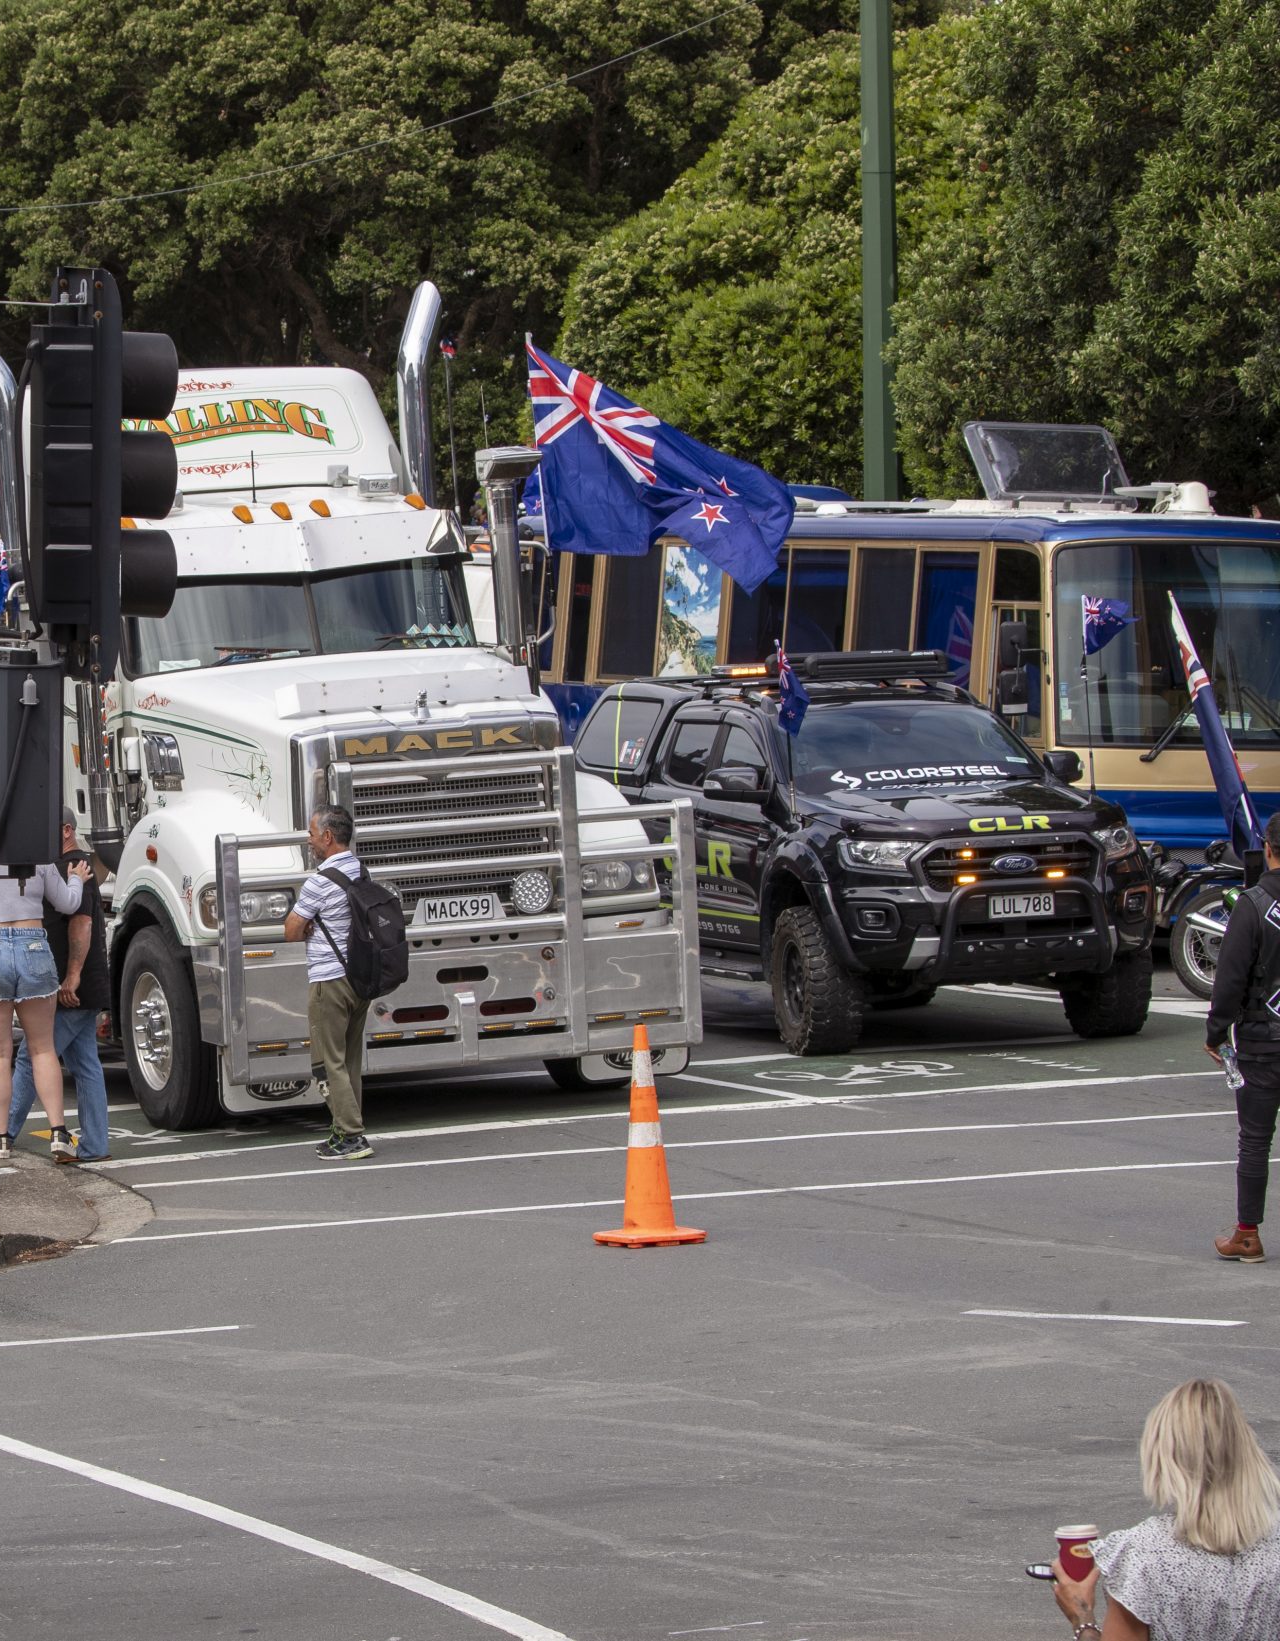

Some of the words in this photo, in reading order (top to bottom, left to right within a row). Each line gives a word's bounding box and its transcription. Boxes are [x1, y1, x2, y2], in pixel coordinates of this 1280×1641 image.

[121, 398, 332, 446] ALLING
[175, 423, 282, 443] TERPRISES
[344, 726, 522, 756] MACK
[865, 765, 1008, 782] COLORSTEEL
[969, 815, 1052, 833] CLR
[1004, 858, 1028, 869] Ford
[699, 883, 720, 892] LONG
[722, 885, 738, 893] RUN
[427, 898, 491, 919] MACK99
[992, 896, 1053, 916] LUL708
